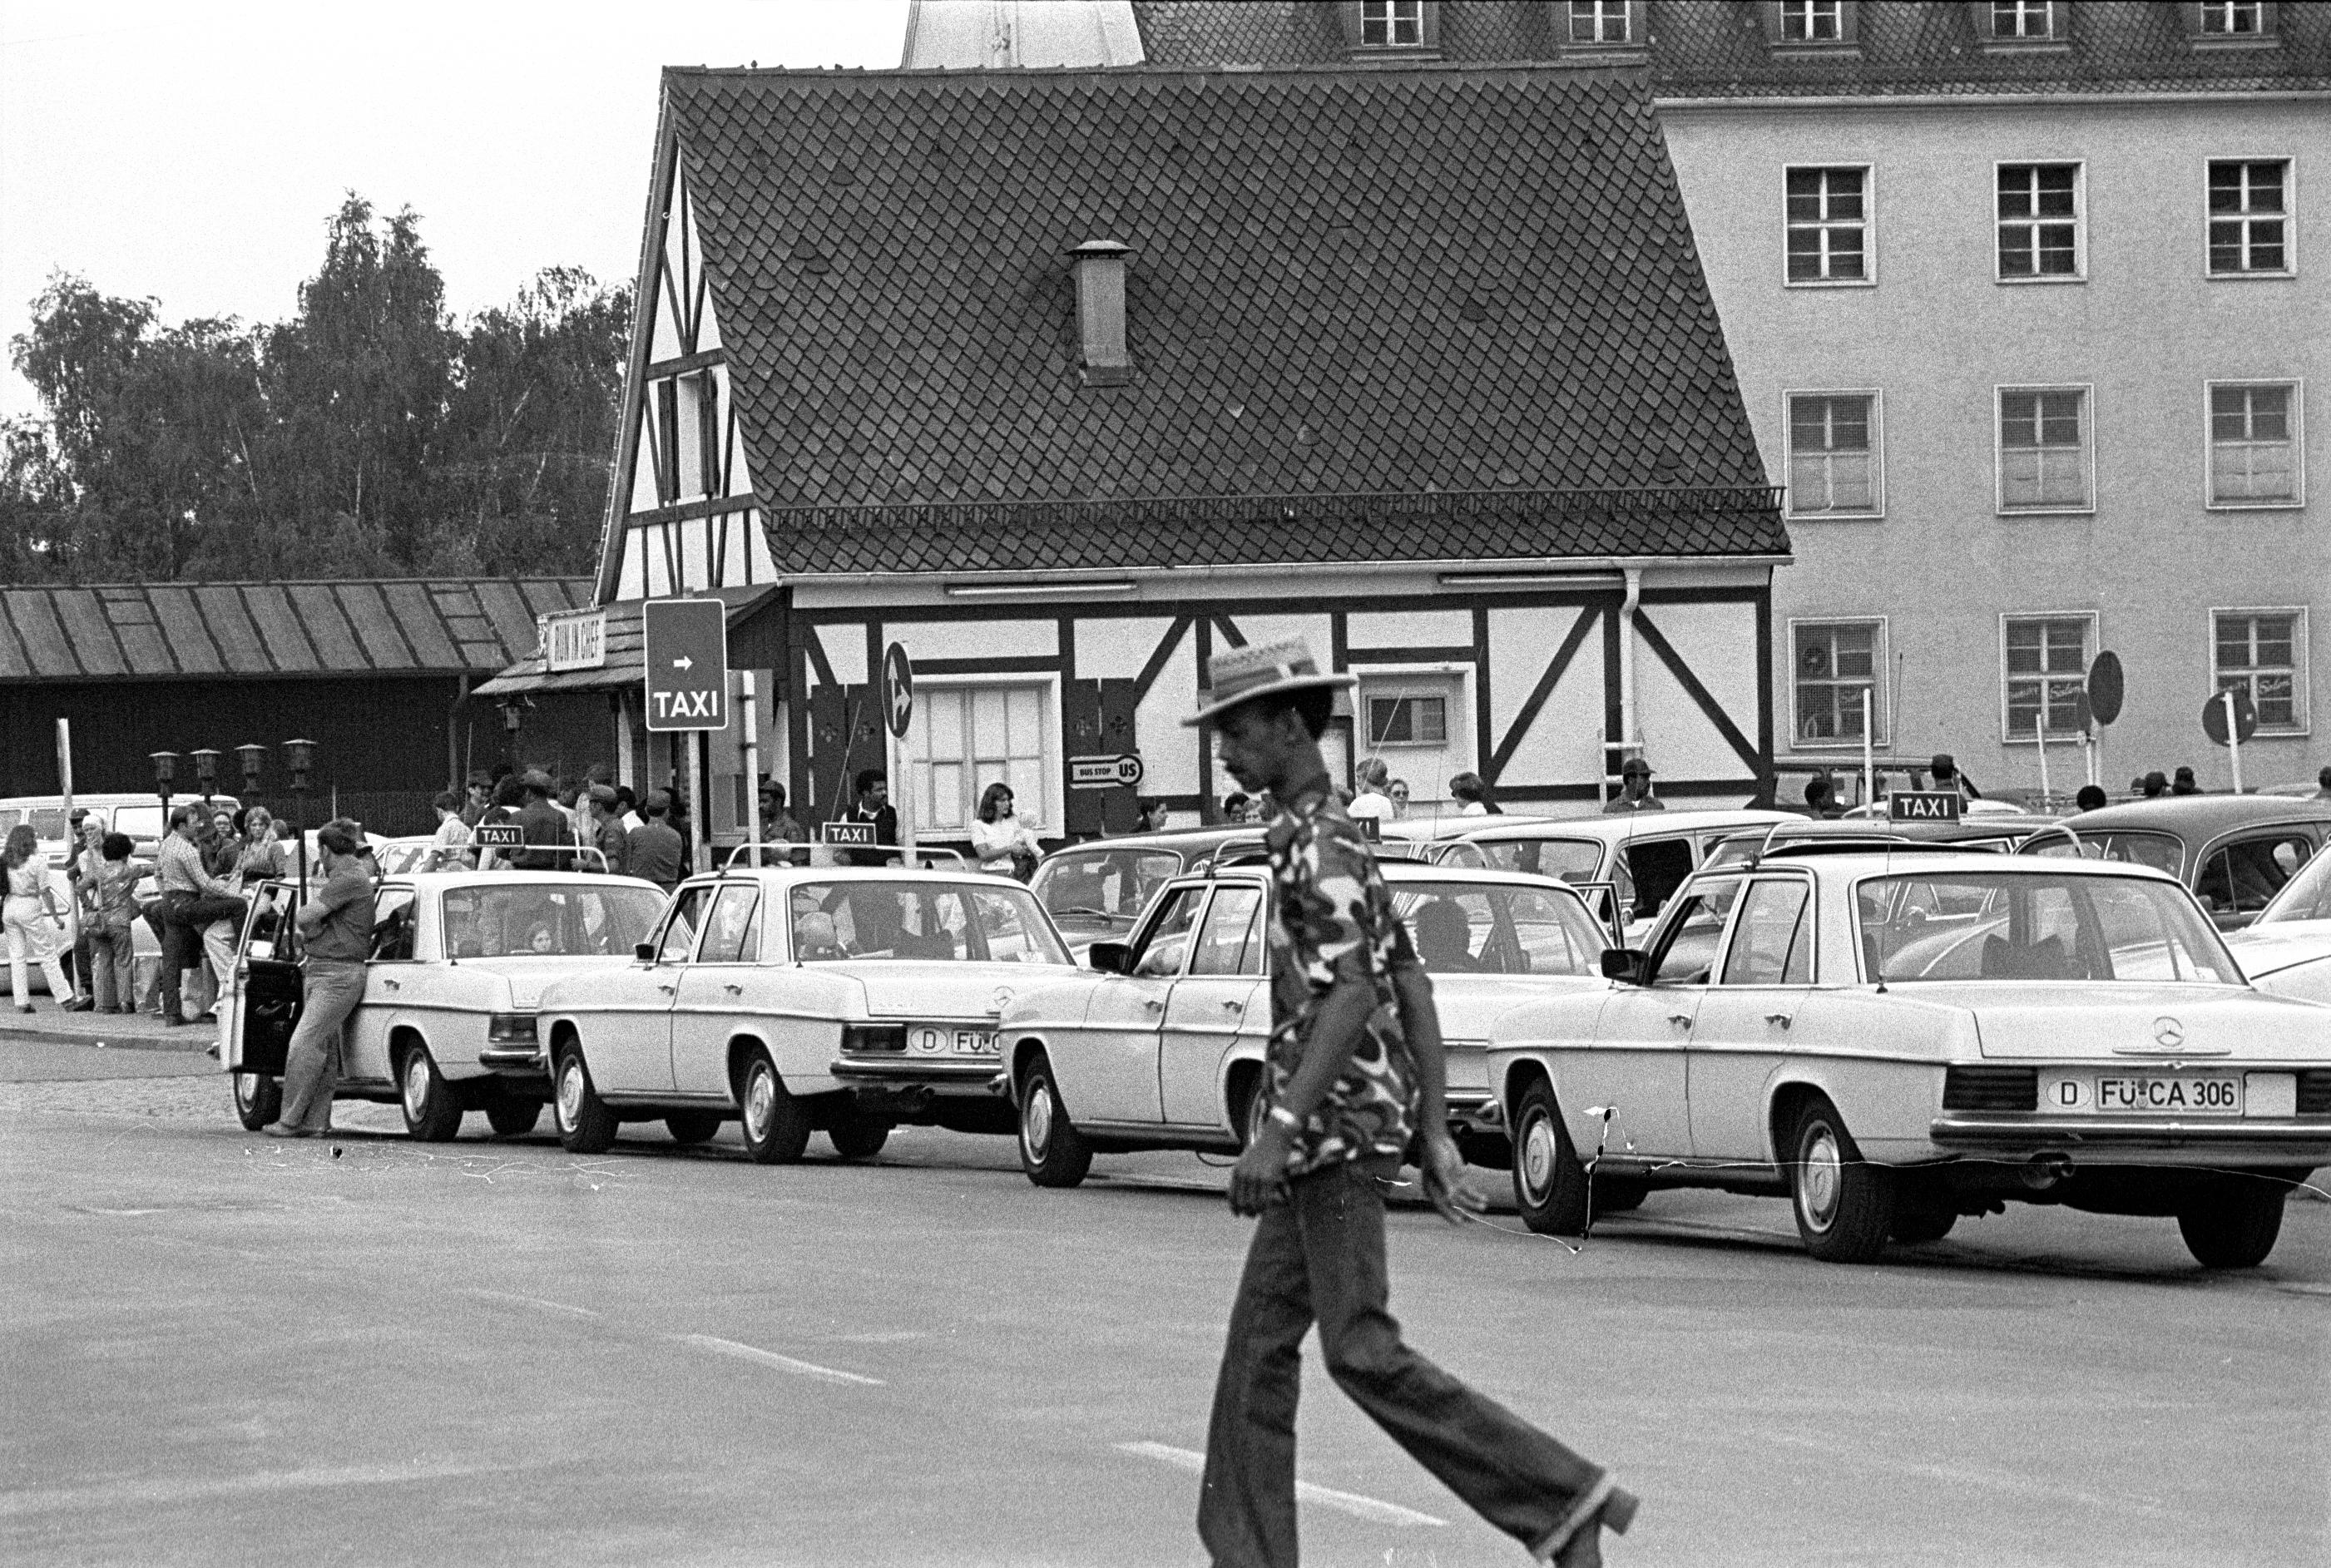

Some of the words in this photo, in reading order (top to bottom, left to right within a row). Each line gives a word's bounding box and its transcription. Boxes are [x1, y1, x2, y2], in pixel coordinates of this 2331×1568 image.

[555, 624, 569, 662] RUN
[572, 622, 579, 660] IN
[654, 690, 718, 718] TAXI
[1094, 767, 1111, 775] STOP
[1118, 763, 1136, 778] US
[1900, 799, 1949, 817] TAXI
[482, 830, 516, 843] TAXI
[831, 828, 868, 842] TAXI
[923, 1030, 937, 1050] D
[2061, 1081, 2078, 1106] D
[2192, 1081, 2235, 1106] 306
